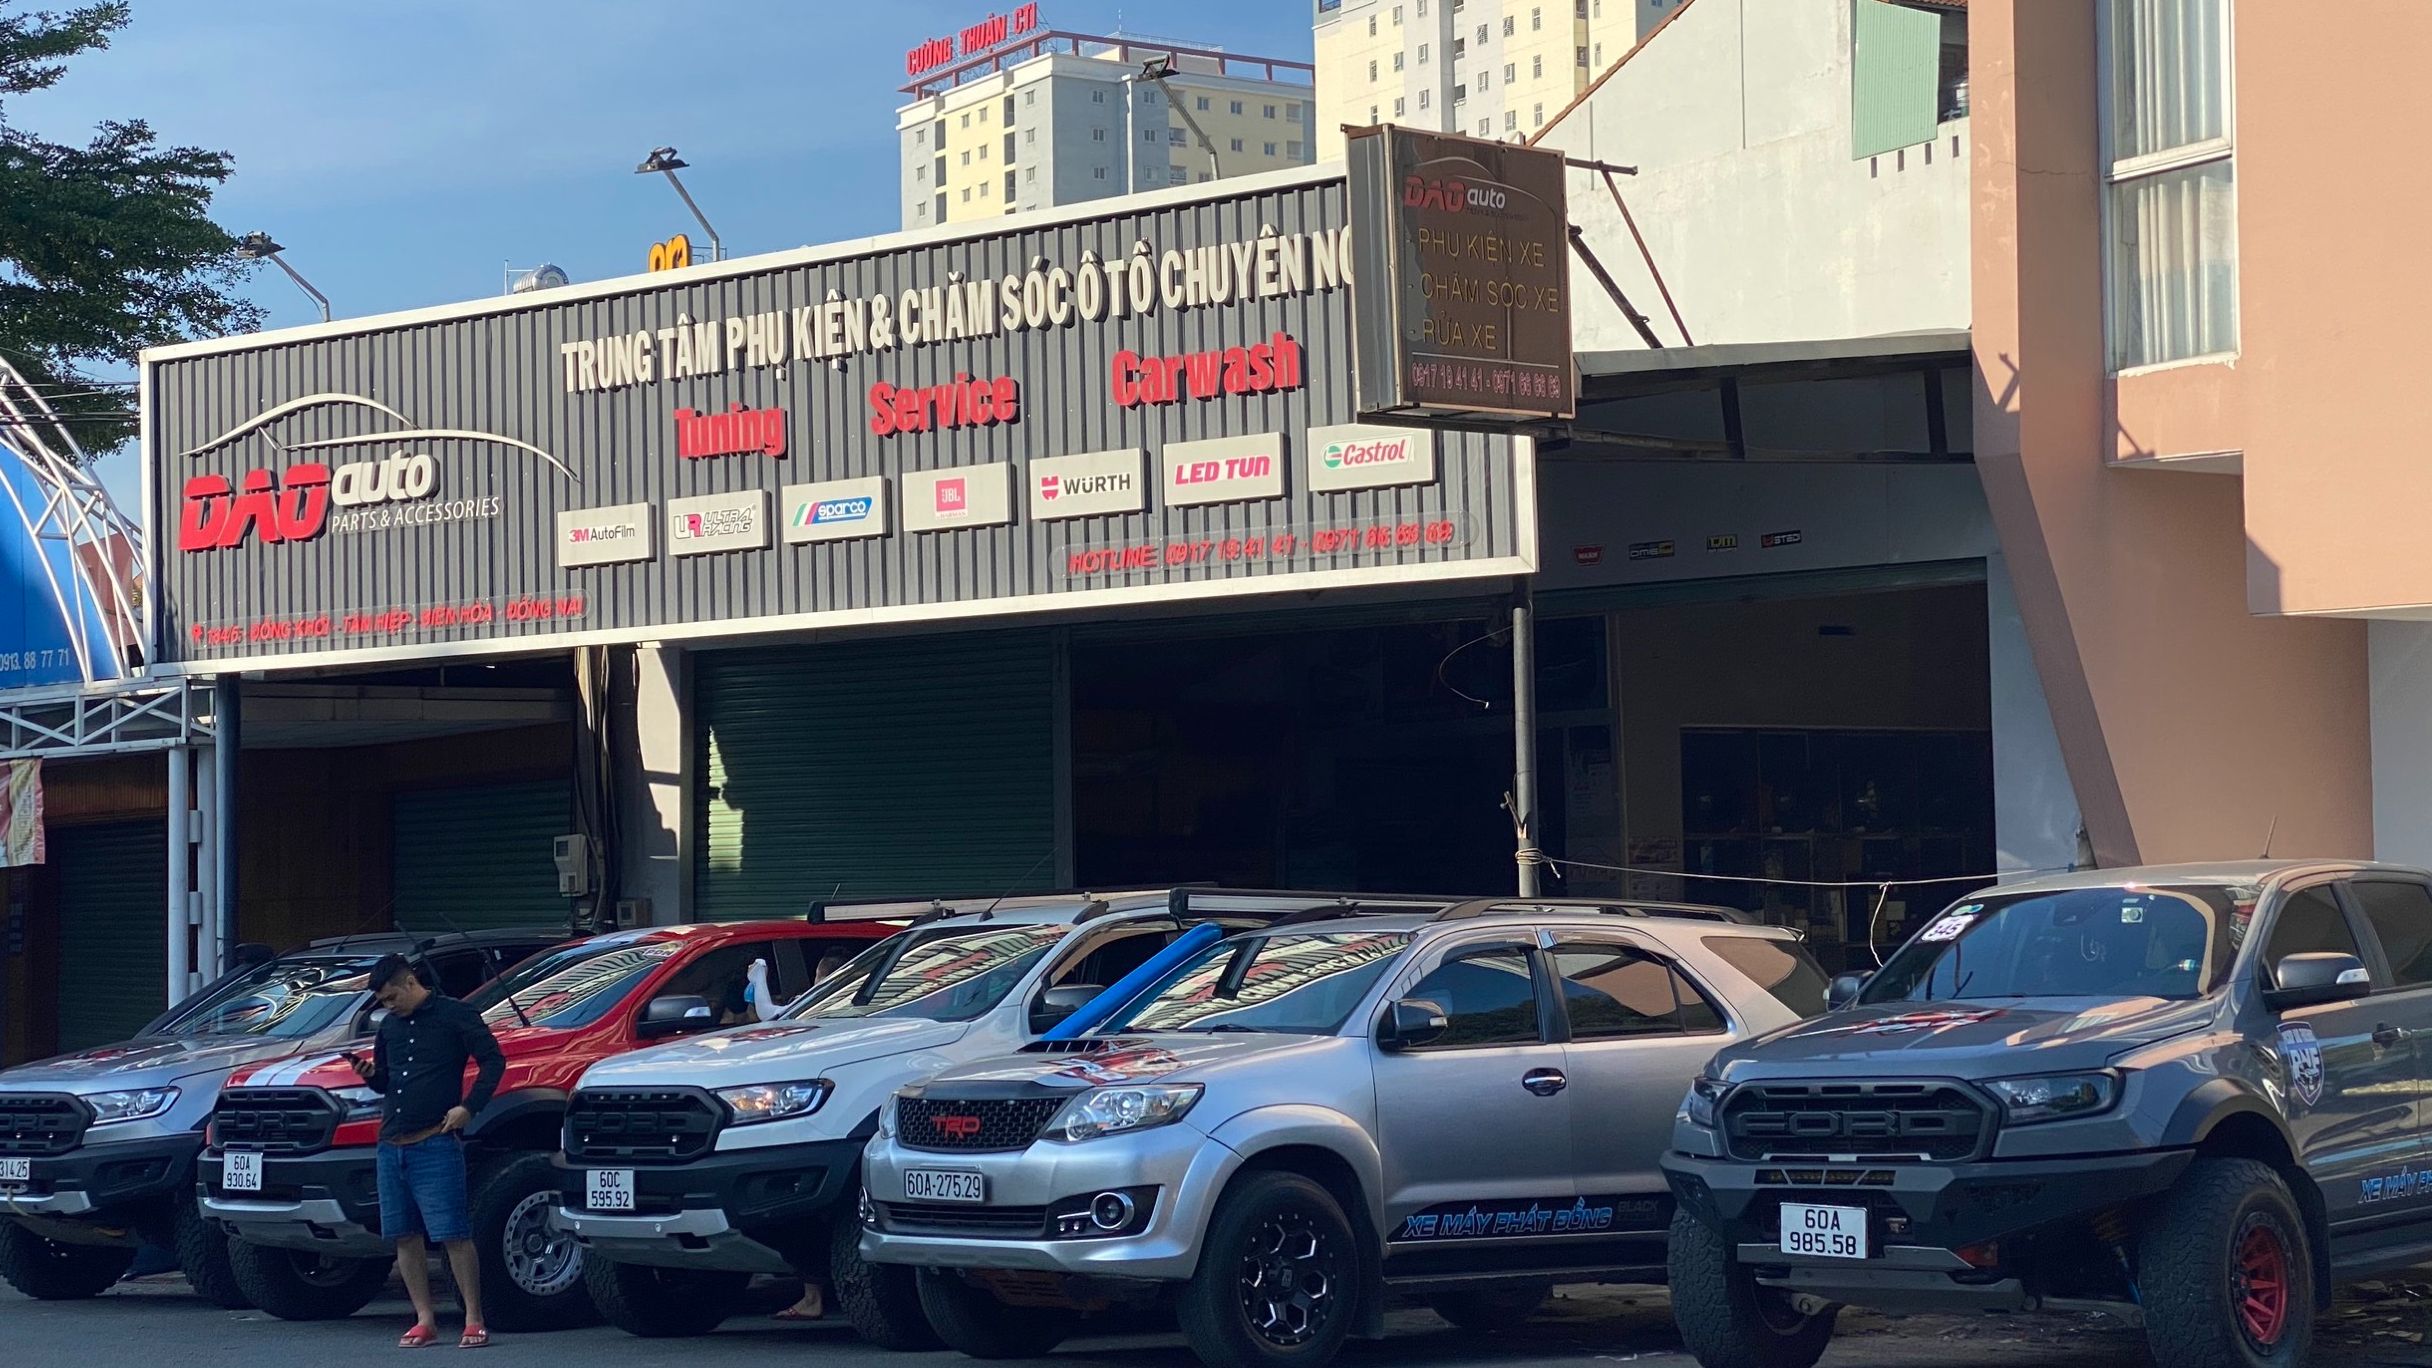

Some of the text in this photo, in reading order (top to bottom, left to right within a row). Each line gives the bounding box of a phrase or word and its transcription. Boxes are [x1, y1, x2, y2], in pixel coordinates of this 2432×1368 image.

[1014, 2, 1038, 34] CTI
[1467, 186, 1506, 209] auto
[1419, 227, 1546, 268] PHỤ KIỆN XE
[1420, 272, 1560, 313] CHĂM SÓC XE
[561, 330, 656, 393] TRUNG
[658, 312, 722, 380] TÂM
[726, 309, 789, 380] PHỤ
[792, 289, 866, 369] KIỆN
[869, 293, 899, 349] &
[900, 271, 998, 346] CHĂM
[1001, 255, 1074, 332] SÓC
[1077, 249, 1105, 322] Ô
[1105, 238, 1157, 317] TÔ
[1160, 224, 1307, 310] CHUYÊN
[1422, 310, 1498, 351] RỬA XE
[1111, 331, 1302, 408] Carwash
[1456, 366, 1468, 391] 41
[1470, 367, 1483, 392] 41
[869, 372, 1018, 436] Service
[674, 402, 788, 459] Tuning
[1342, 439, 1407, 466] Castrol
[331, 450, 439, 507] auto
[1063, 472, 1131, 495] WÜRTH
[1175, 462, 1222, 485] LED
[941, 487, 961, 503] JBL
[332, 496, 500, 534] PARTS & ACCESSORIES
[705, 507, 752, 523] ULTRA
[818, 501, 866, 520] sparco
[568, 524, 635, 544] 3M AutoFilm
[1069, 545, 1157, 574] HOTLINE
[1165, 540, 1211, 566] 0917
[1243, 536, 1265, 559] 41
[1271, 534, 1296, 557] 41
[1312, 529, 1361, 553] 0971
[24, 650, 37, 670] 88
[41, 650, 54, 669] 77
[58, 648, 70, 667] 71
[932, 1116, 981, 1139] TRD
[233, 1155, 251, 1171] 60A
[226, 1172, 258, 1189] 930.64
[599, 1171, 621, 1188] 60C
[907, 1168, 981, 1198] 60A-275.29
[2357, 1178, 2383, 1204] XE
[2383, 1165, 2418, 1200] MÁY
[591, 1190, 629, 1208] 595.92
[1402, 1215, 1435, 1238] XE
[1438, 1205, 1493, 1236] MÁY
[1493, 1202, 1552, 1233] PHÁT
[1804, 1209, 1841, 1231] 60A
[1789, 1234, 1857, 1256] 985.58
